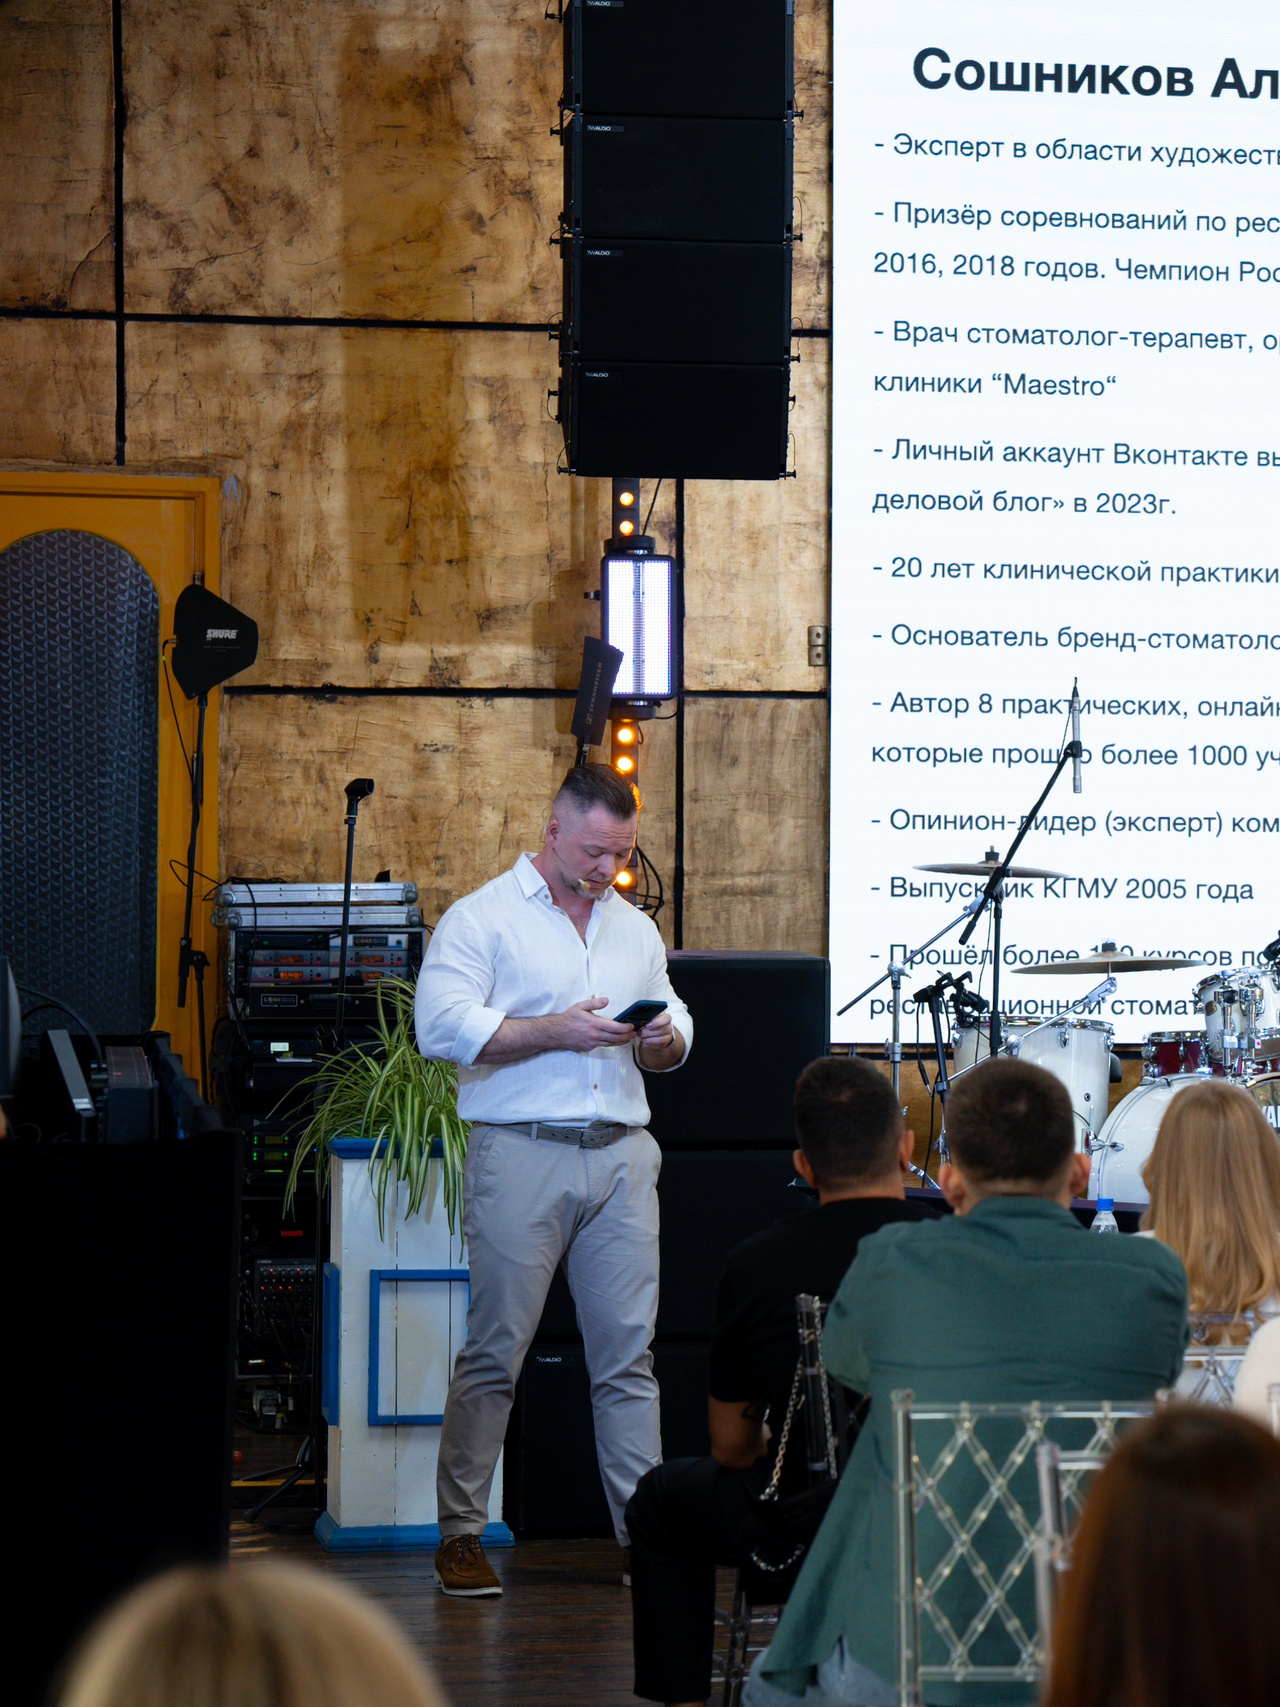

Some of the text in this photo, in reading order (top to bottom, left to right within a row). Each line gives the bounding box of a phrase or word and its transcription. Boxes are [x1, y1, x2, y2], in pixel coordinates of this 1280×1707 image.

[912, 46, 1195, 96] Сошников
[893, 132, 1005, 162] Эксперт
[1013, 142, 1027, 159] в
[1035, 137, 1142, 161] области
[894, 201, 992, 230] Призёр
[1000, 209, 1187, 232] соревнований
[1196, 215, 1227, 232] по
[873, 251, 943, 277] 2016,
[953, 253, 1015, 276] 2018
[1024, 261, 1106, 281] годов.
[1115, 257, 1229, 281] Чемпион
[894, 320, 958, 347] Врач
[967, 327, 1253, 352] стоматолог-терапевт,
[874, 372, 1116, 395] клиники “Maestro“
[891, 438, 994, 461] Личный
[1002, 445, 1105, 468] аккаунт
[1114, 442, 1248, 466] Вконтакте
[871, 489, 1177, 514] деловой блог» в 2023г.
[891, 556, 922, 578] 20
[930, 562, 976, 578] лет
[983, 560, 1151, 581] клинической
[206, 628, 238, 640] SHURE
[891, 623, 1049, 646] Основатель
[889, 691, 970, 718] Автор
[978, 693, 993, 714] 8
[1001, 697, 1188, 720] практических,
[872, 746, 983, 767] которые
[992, 747, 1093, 768] прошо
[1101, 743, 1178, 765] более
[1188, 744, 1248, 765] 1000
[1105, 810, 1223, 837] (эксперт)
[890, 876, 1035, 903] Выпускик
[1043, 876, 1118, 898] КГМУ
[1125, 878, 1187, 898] 2005
[1196, 883, 1254, 903] года
[889, 943, 994, 970] Прошёл
[1002, 943, 1081, 965] более
